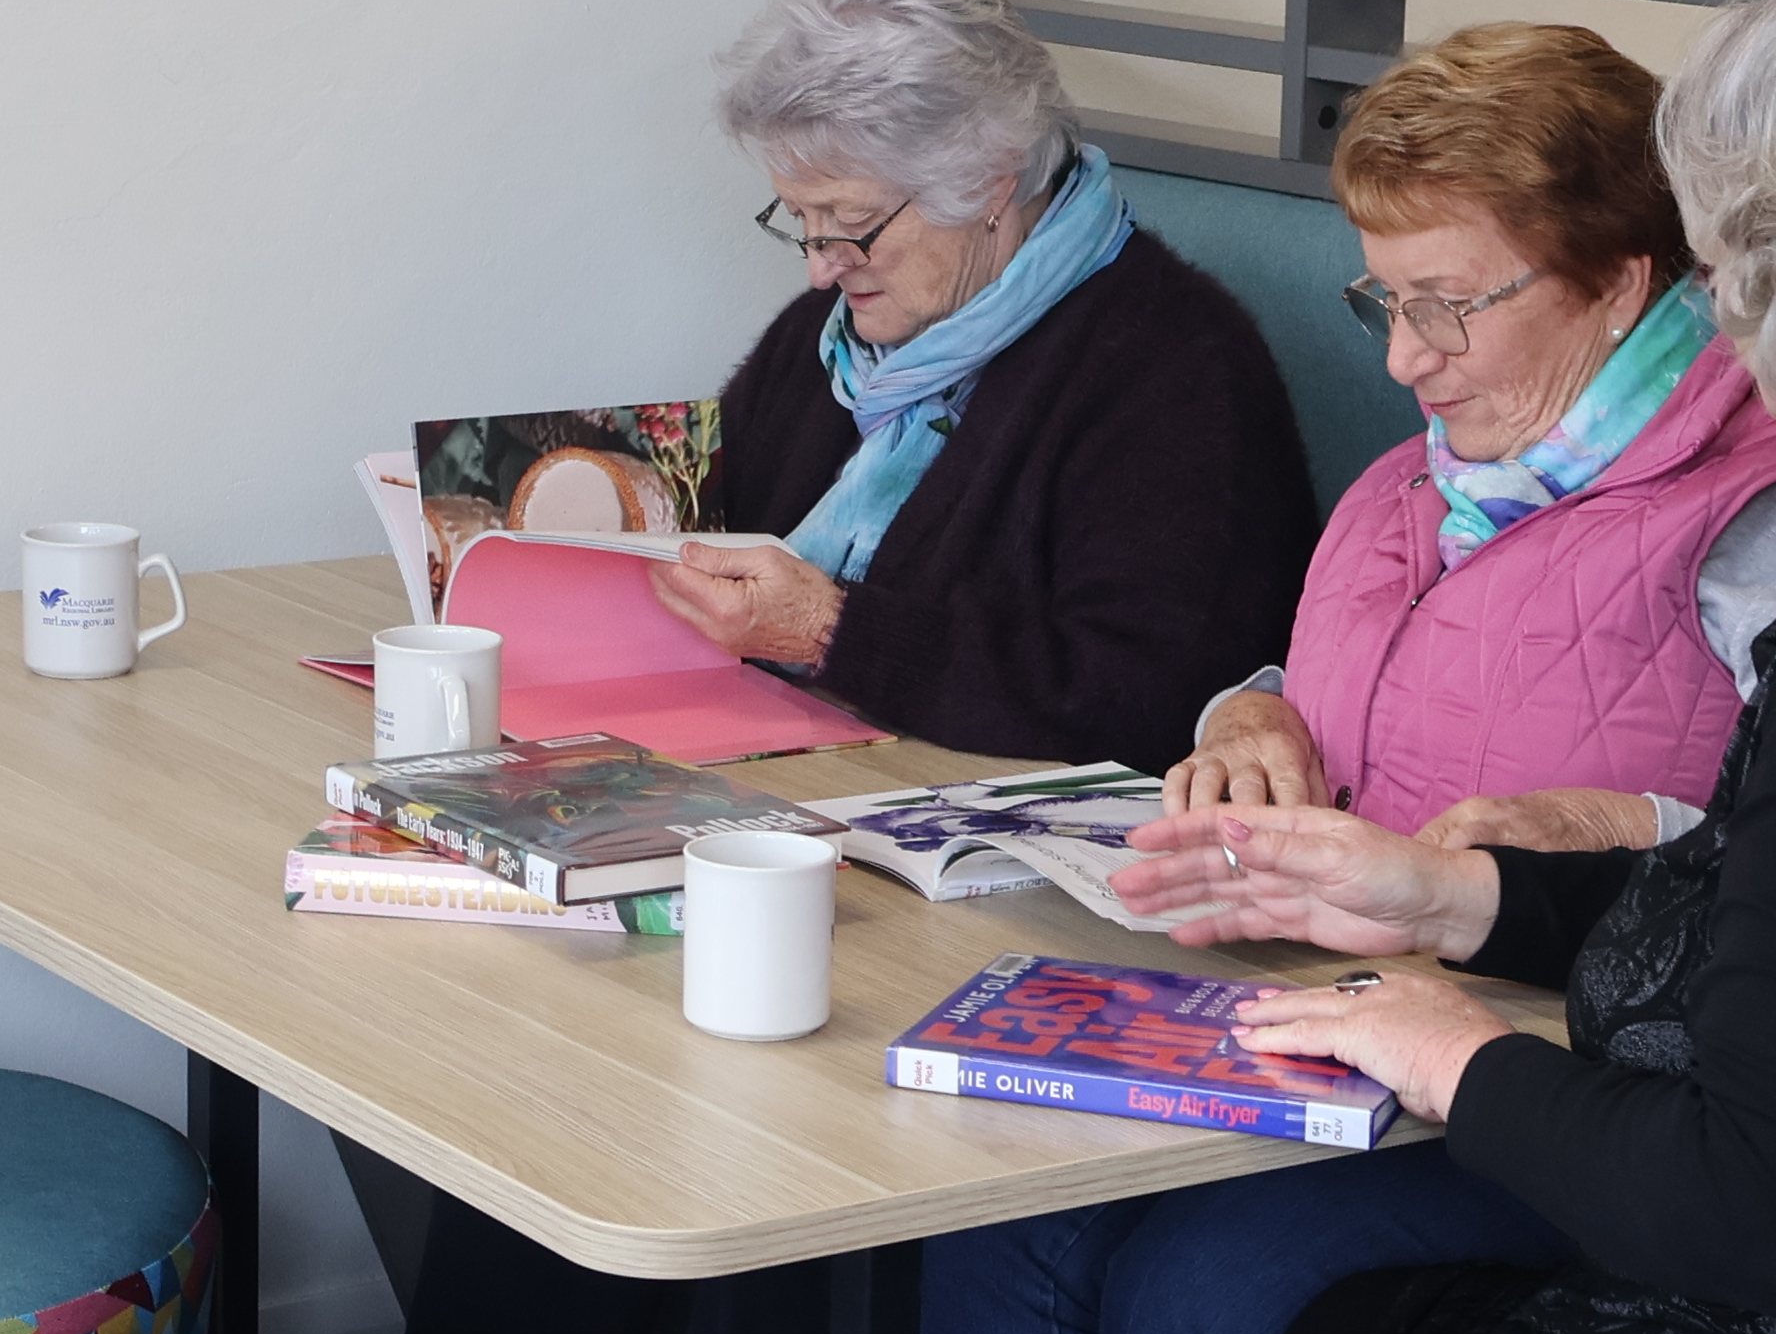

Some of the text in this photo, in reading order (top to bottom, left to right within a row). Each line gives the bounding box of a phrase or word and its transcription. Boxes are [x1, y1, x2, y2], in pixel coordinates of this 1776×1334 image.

[43, 616, 115, 630] mrl.nsw.gov.au
[372, 752, 529, 778] Jackson
[359, 790, 382, 817] Pollock
[396, 806, 408, 828] The
[409, 812, 425, 839] Early
[426, 819, 446, 845] Years:
[665, 810, 816, 840] Pollock
[918, 966, 1154, 1057] Easy
[943, 990, 996, 1023] JAMIE
[1065, 1012, 1227, 1075] Air
[914, 1059, 922, 1087] Quick
[925, 1064, 933, 1085] Pick
[996, 1075, 1075, 1100] OLIVER
[1128, 1087, 1261, 1127] Easy Air Fryer
[1334, 1117, 1343, 1141] OLIV
